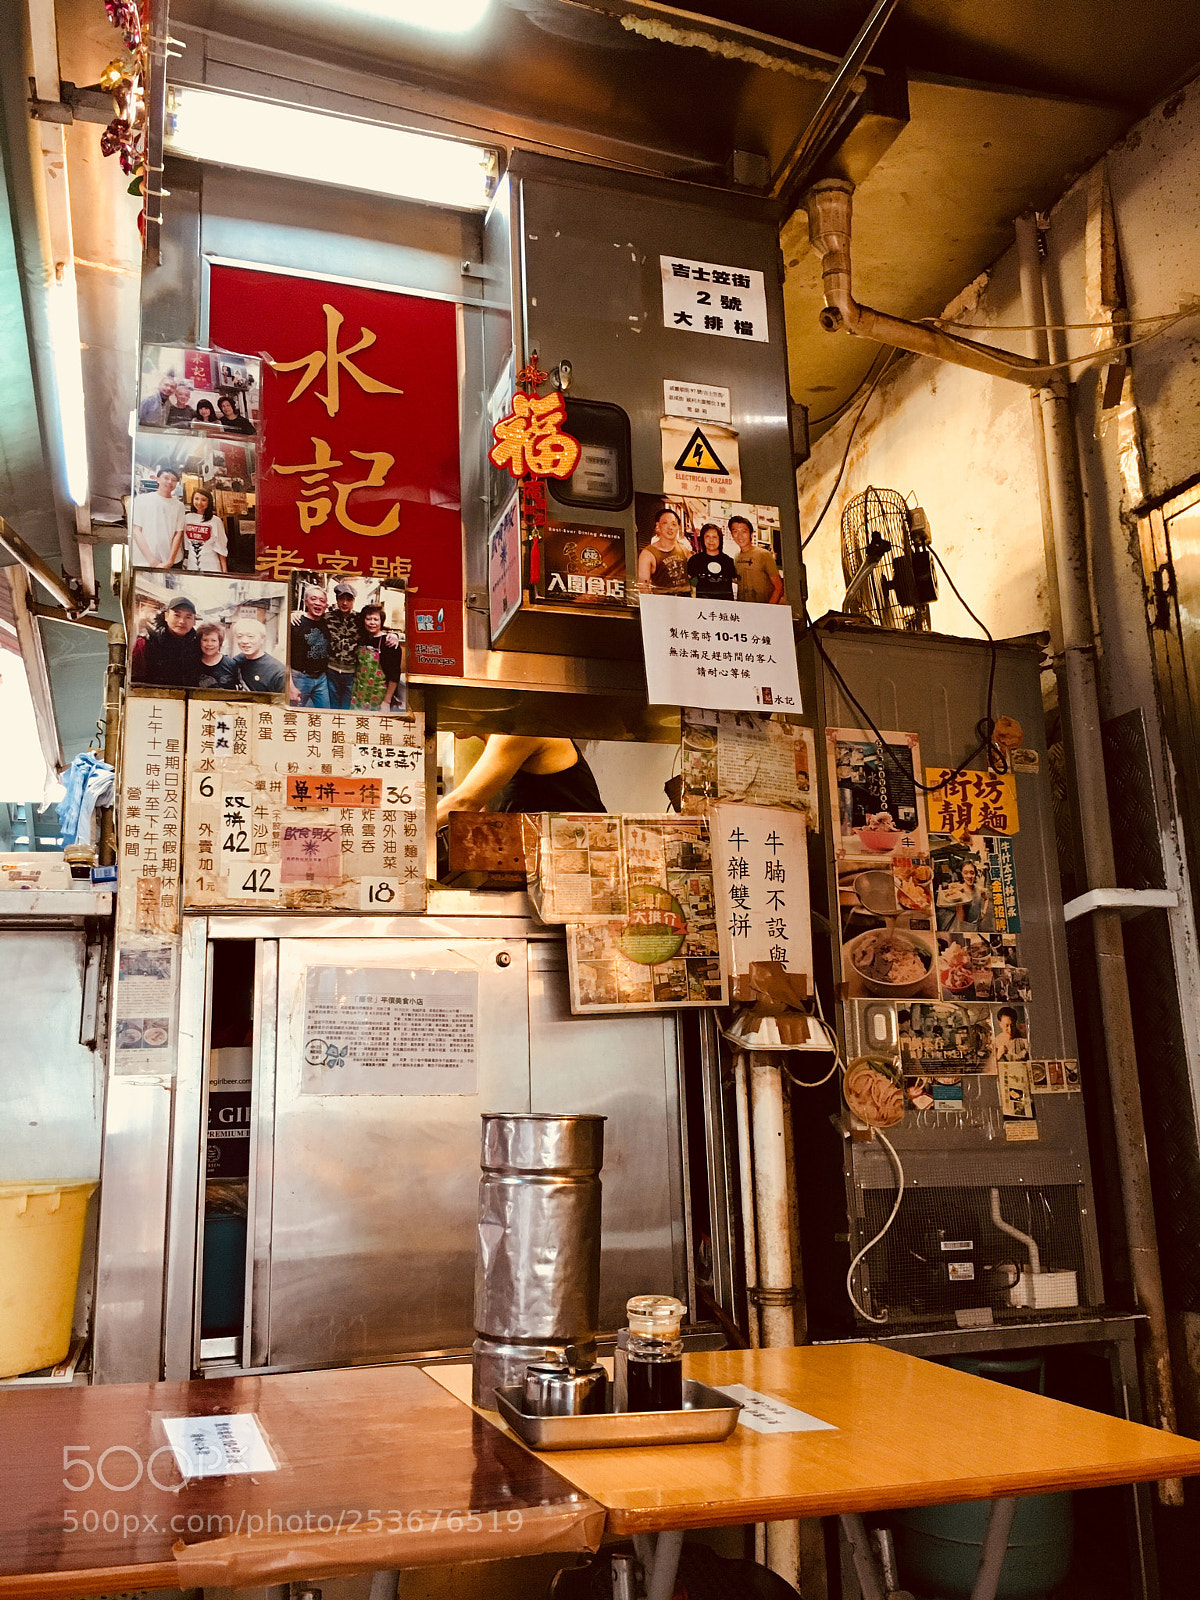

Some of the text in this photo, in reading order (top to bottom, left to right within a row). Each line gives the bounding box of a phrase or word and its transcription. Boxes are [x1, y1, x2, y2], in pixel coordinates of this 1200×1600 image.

[671, 263, 750, 288] 吉士笠街
[673, 311, 753, 336] 大排檔
[270, 303, 404, 537] 水記
[489, 391, 580, 478] 福
[675, 473, 732, 485] ELECTRICAL HAZARD
[578, 530, 597, 538] Dining
[547, 572, 625, 598] 入圍食店
[697, 611, 740, 623] 人手短缺
[669, 627, 772, 646] 製作需時 10-15 分鐘
[417, 655, 456, 667] Towngas
[669, 647, 777, 664] 無法滿足趕時間的客人
[697, 667, 751, 679] 請耐心等候
[774, 694, 795, 706] 水記
[233, 716, 248, 755] 魚皮餃
[258, 711, 273, 741] 魚蛋
[283, 712, 298, 742] 雲吞
[307, 713, 322, 758] 豬肉丸
[332, 715, 346, 759] 牛脆骨
[379, 717, 393, 745] 牛腩
[200, 776, 214, 798] 6
[386, 786, 412, 804] 36
[125, 786, 142, 857] 營業時間
[284, 826, 338, 842] 飲食男女
[340, 808, 354, 854] 炸魚皮
[361, 809, 376, 854] 炸雲吞
[223, 831, 250, 853] 42
[382, 810, 397, 870] 郊外油菜
[242, 868, 275, 893] 42
[368, 882, 395, 904] 18
[727, 826, 752, 938] 牛雜雙拼
